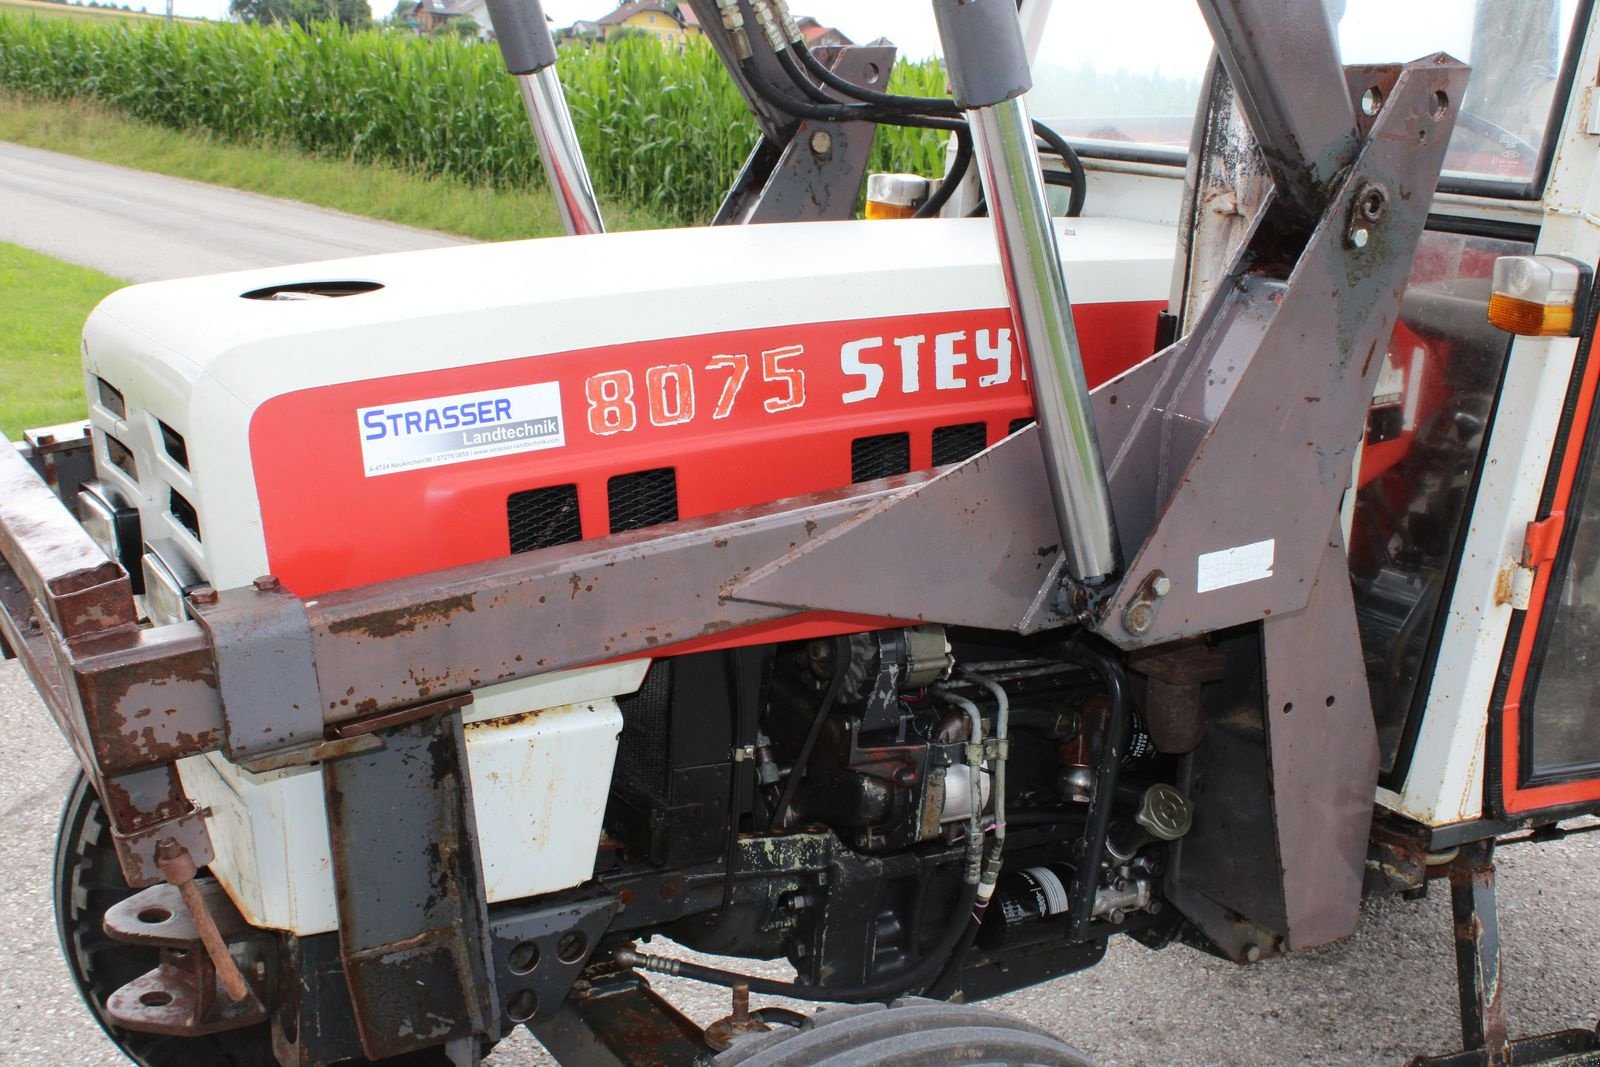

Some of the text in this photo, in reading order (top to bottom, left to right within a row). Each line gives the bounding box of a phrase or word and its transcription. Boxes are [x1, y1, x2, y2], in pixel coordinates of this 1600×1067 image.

[585, 344, 806, 435] 8075
[841, 328, 1028, 404] STEY
[462, 420, 558, 446] Landtechnik
